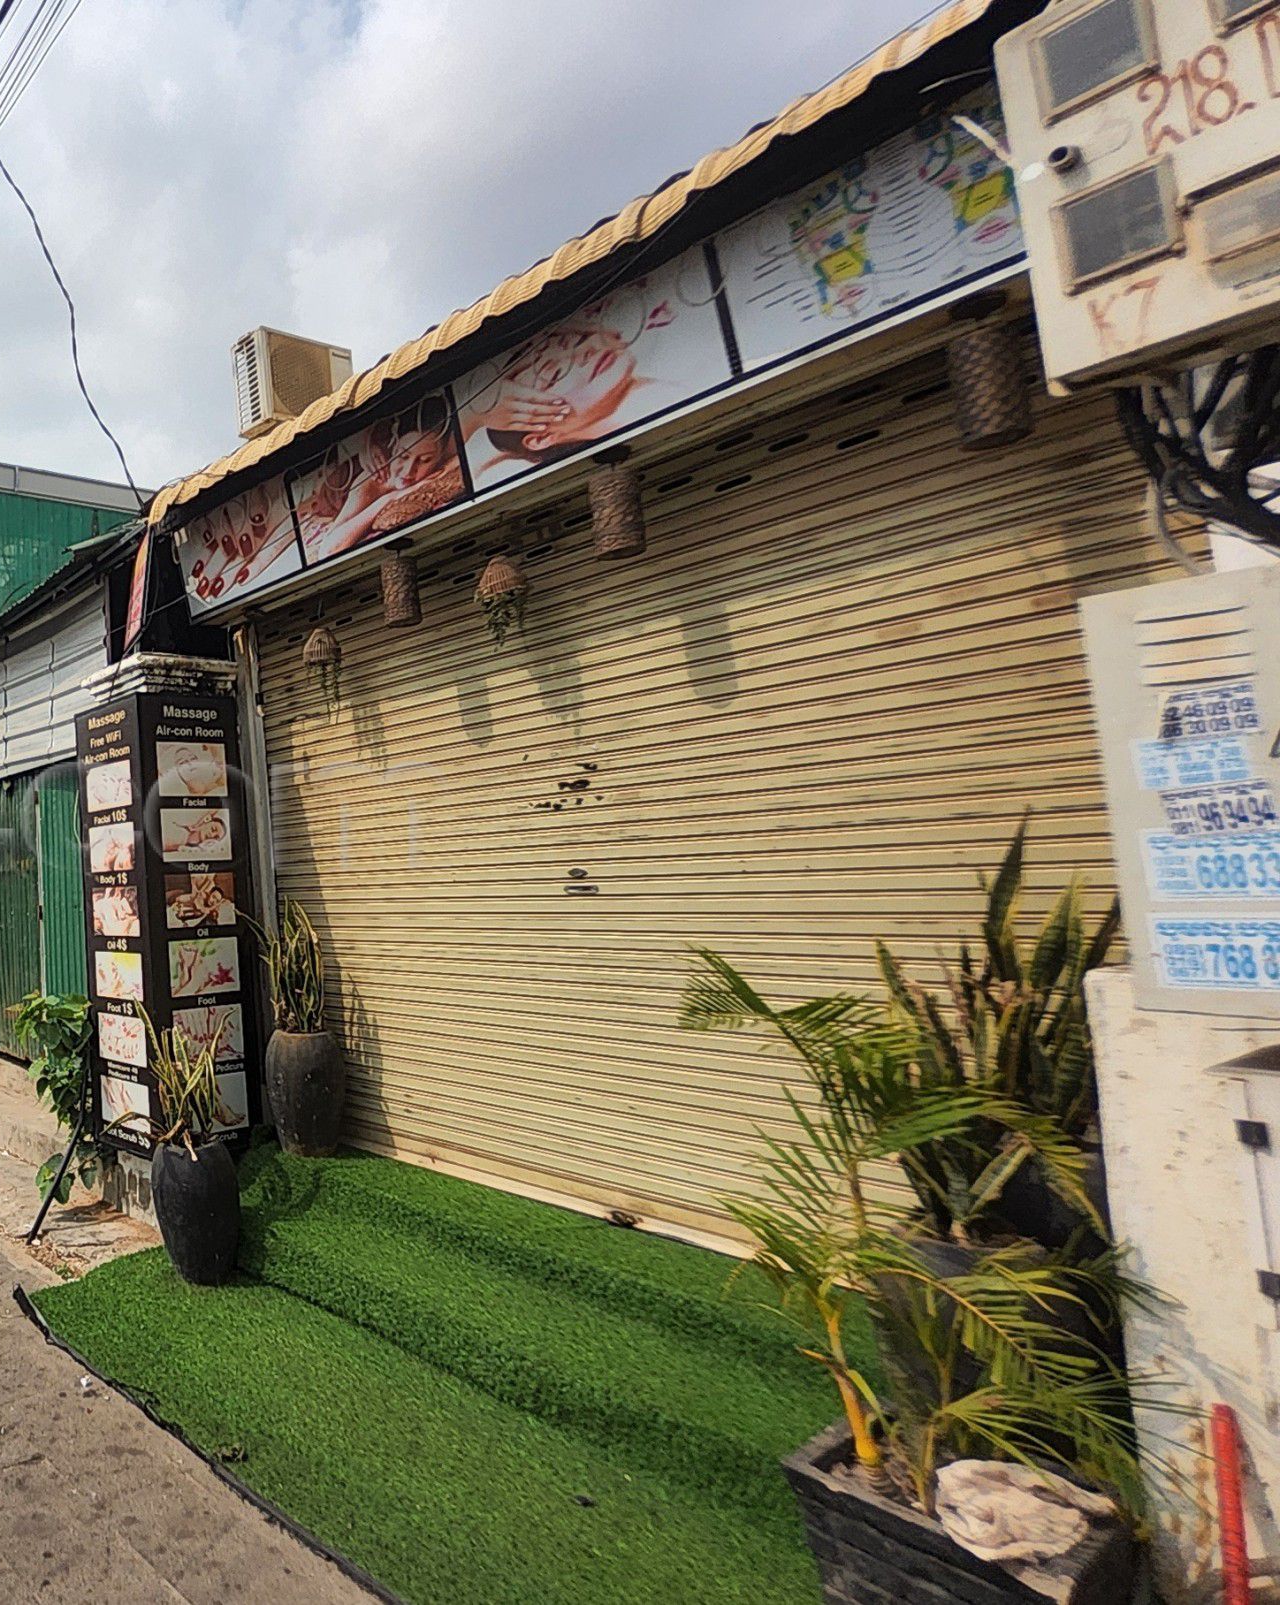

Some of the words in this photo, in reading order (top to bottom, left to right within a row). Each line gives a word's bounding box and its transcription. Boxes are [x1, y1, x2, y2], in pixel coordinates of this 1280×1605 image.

[163, 705, 218, 722] Massage
[88, 709, 126, 730] Massage
[155, 724, 193, 736] Air-con
[195, 726, 224, 738] Room
[90, 737, 105, 749] Free
[84, 751, 108, 765] Air-con
[109, 745, 131, 758] Room
[182, 797, 207, 806] Facial
[111, 808, 127, 822] 10$
[187, 862, 209, 873] Body
[100, 875, 116, 885] Body
[197, 928, 209, 937] Oil
[197, 996, 217, 1006] Foot
[107, 1002, 121, 1013] Foot
[215, 1062, 244, 1072] Pedicure
[117, 1128, 138, 1143] Scrub
[218, 1132, 238, 1142] crub
